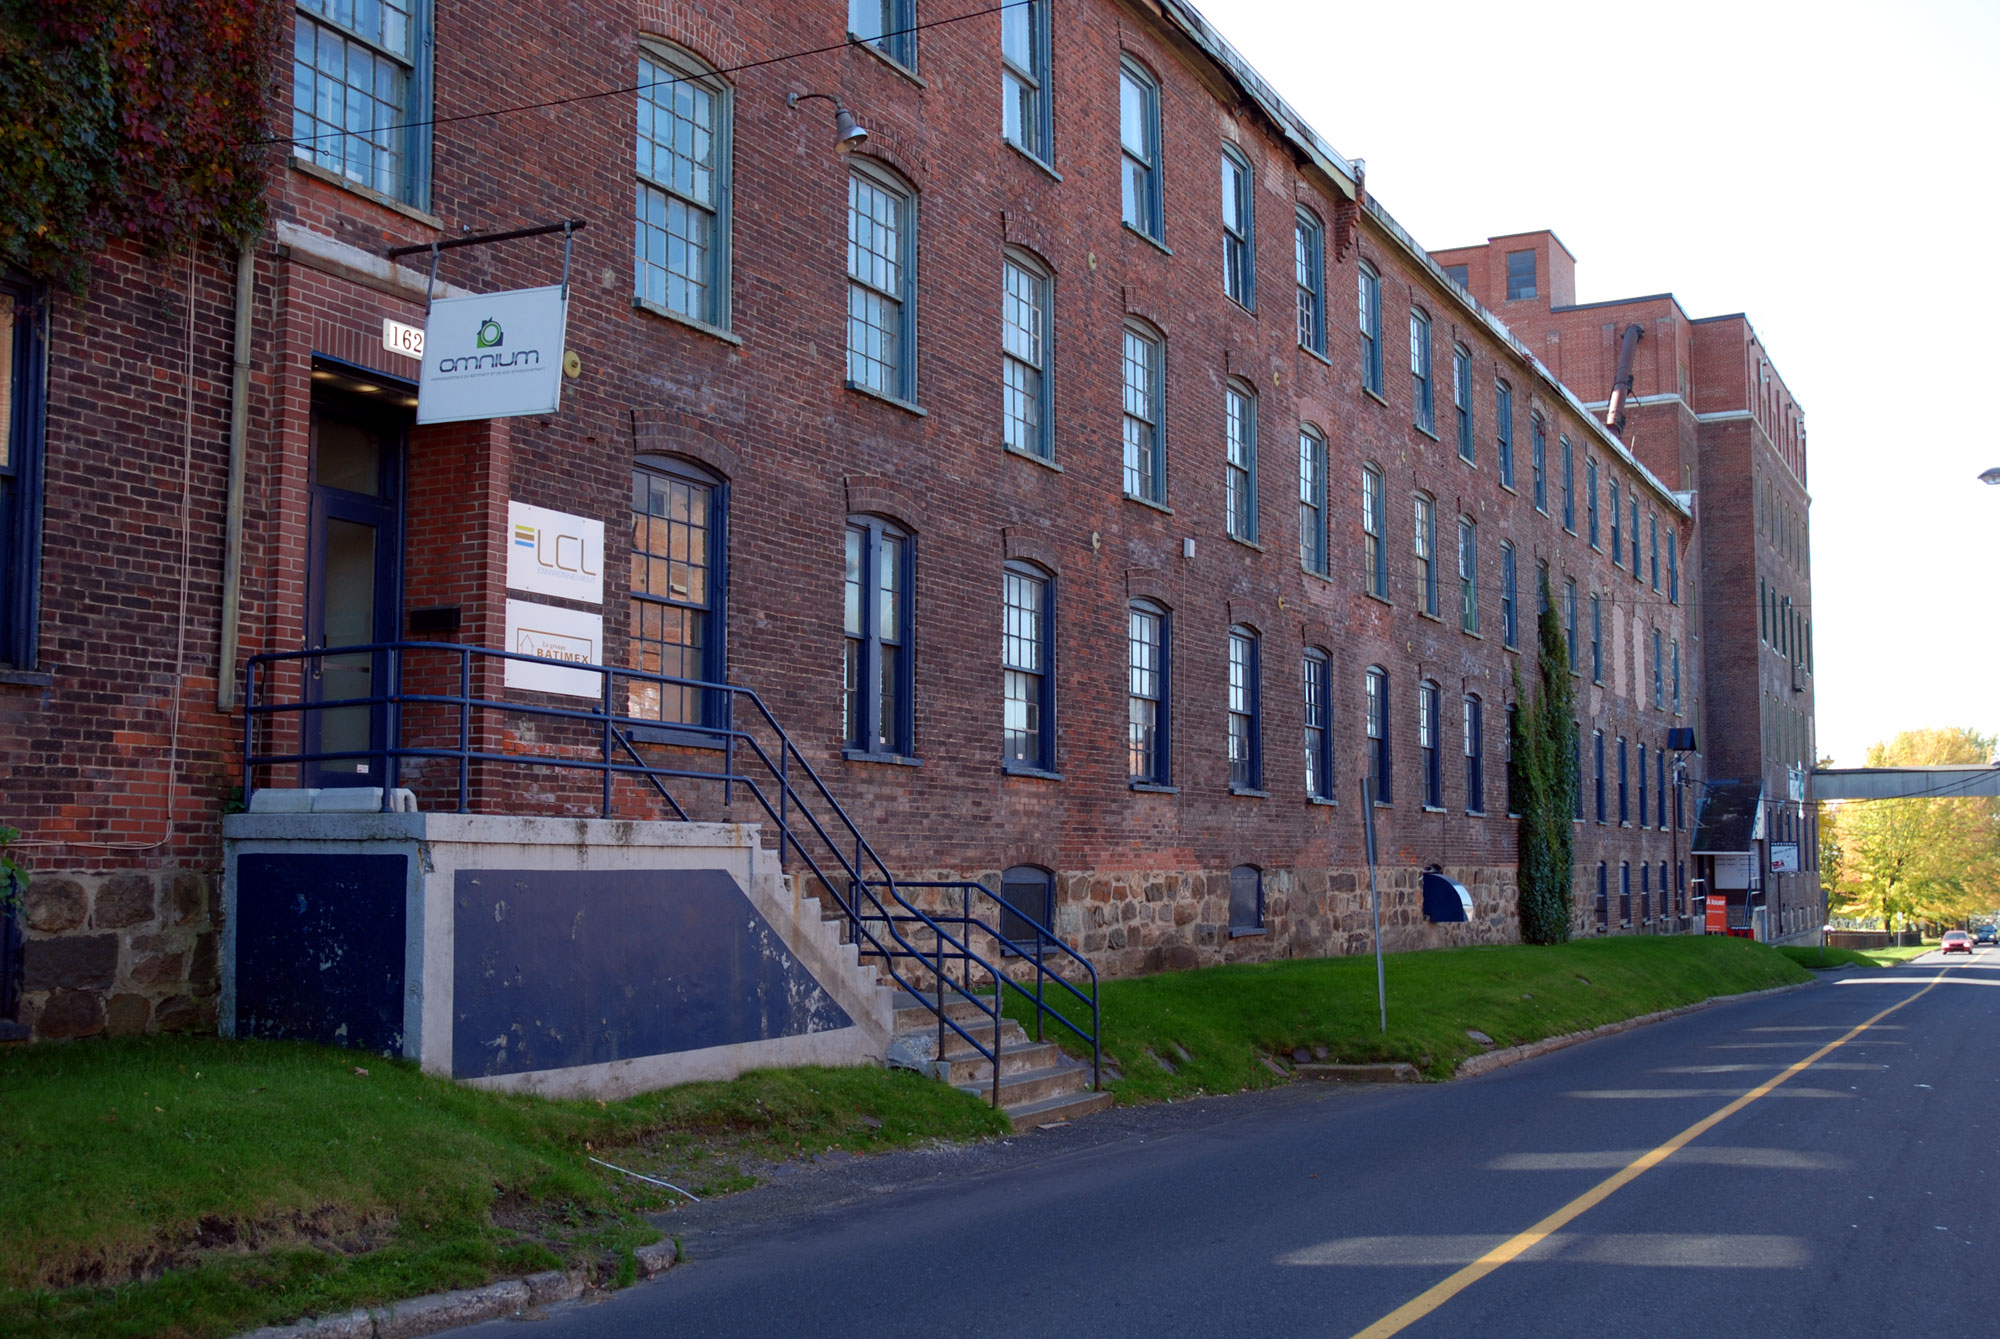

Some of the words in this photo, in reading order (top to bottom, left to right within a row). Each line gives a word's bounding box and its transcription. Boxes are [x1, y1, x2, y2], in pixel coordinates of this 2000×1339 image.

[393, 326, 423, 353] 162
[439, 350, 539, 373] omnium
[537, 529, 596, 576] LCL
[537, 648, 589, 664] BATIMEX
